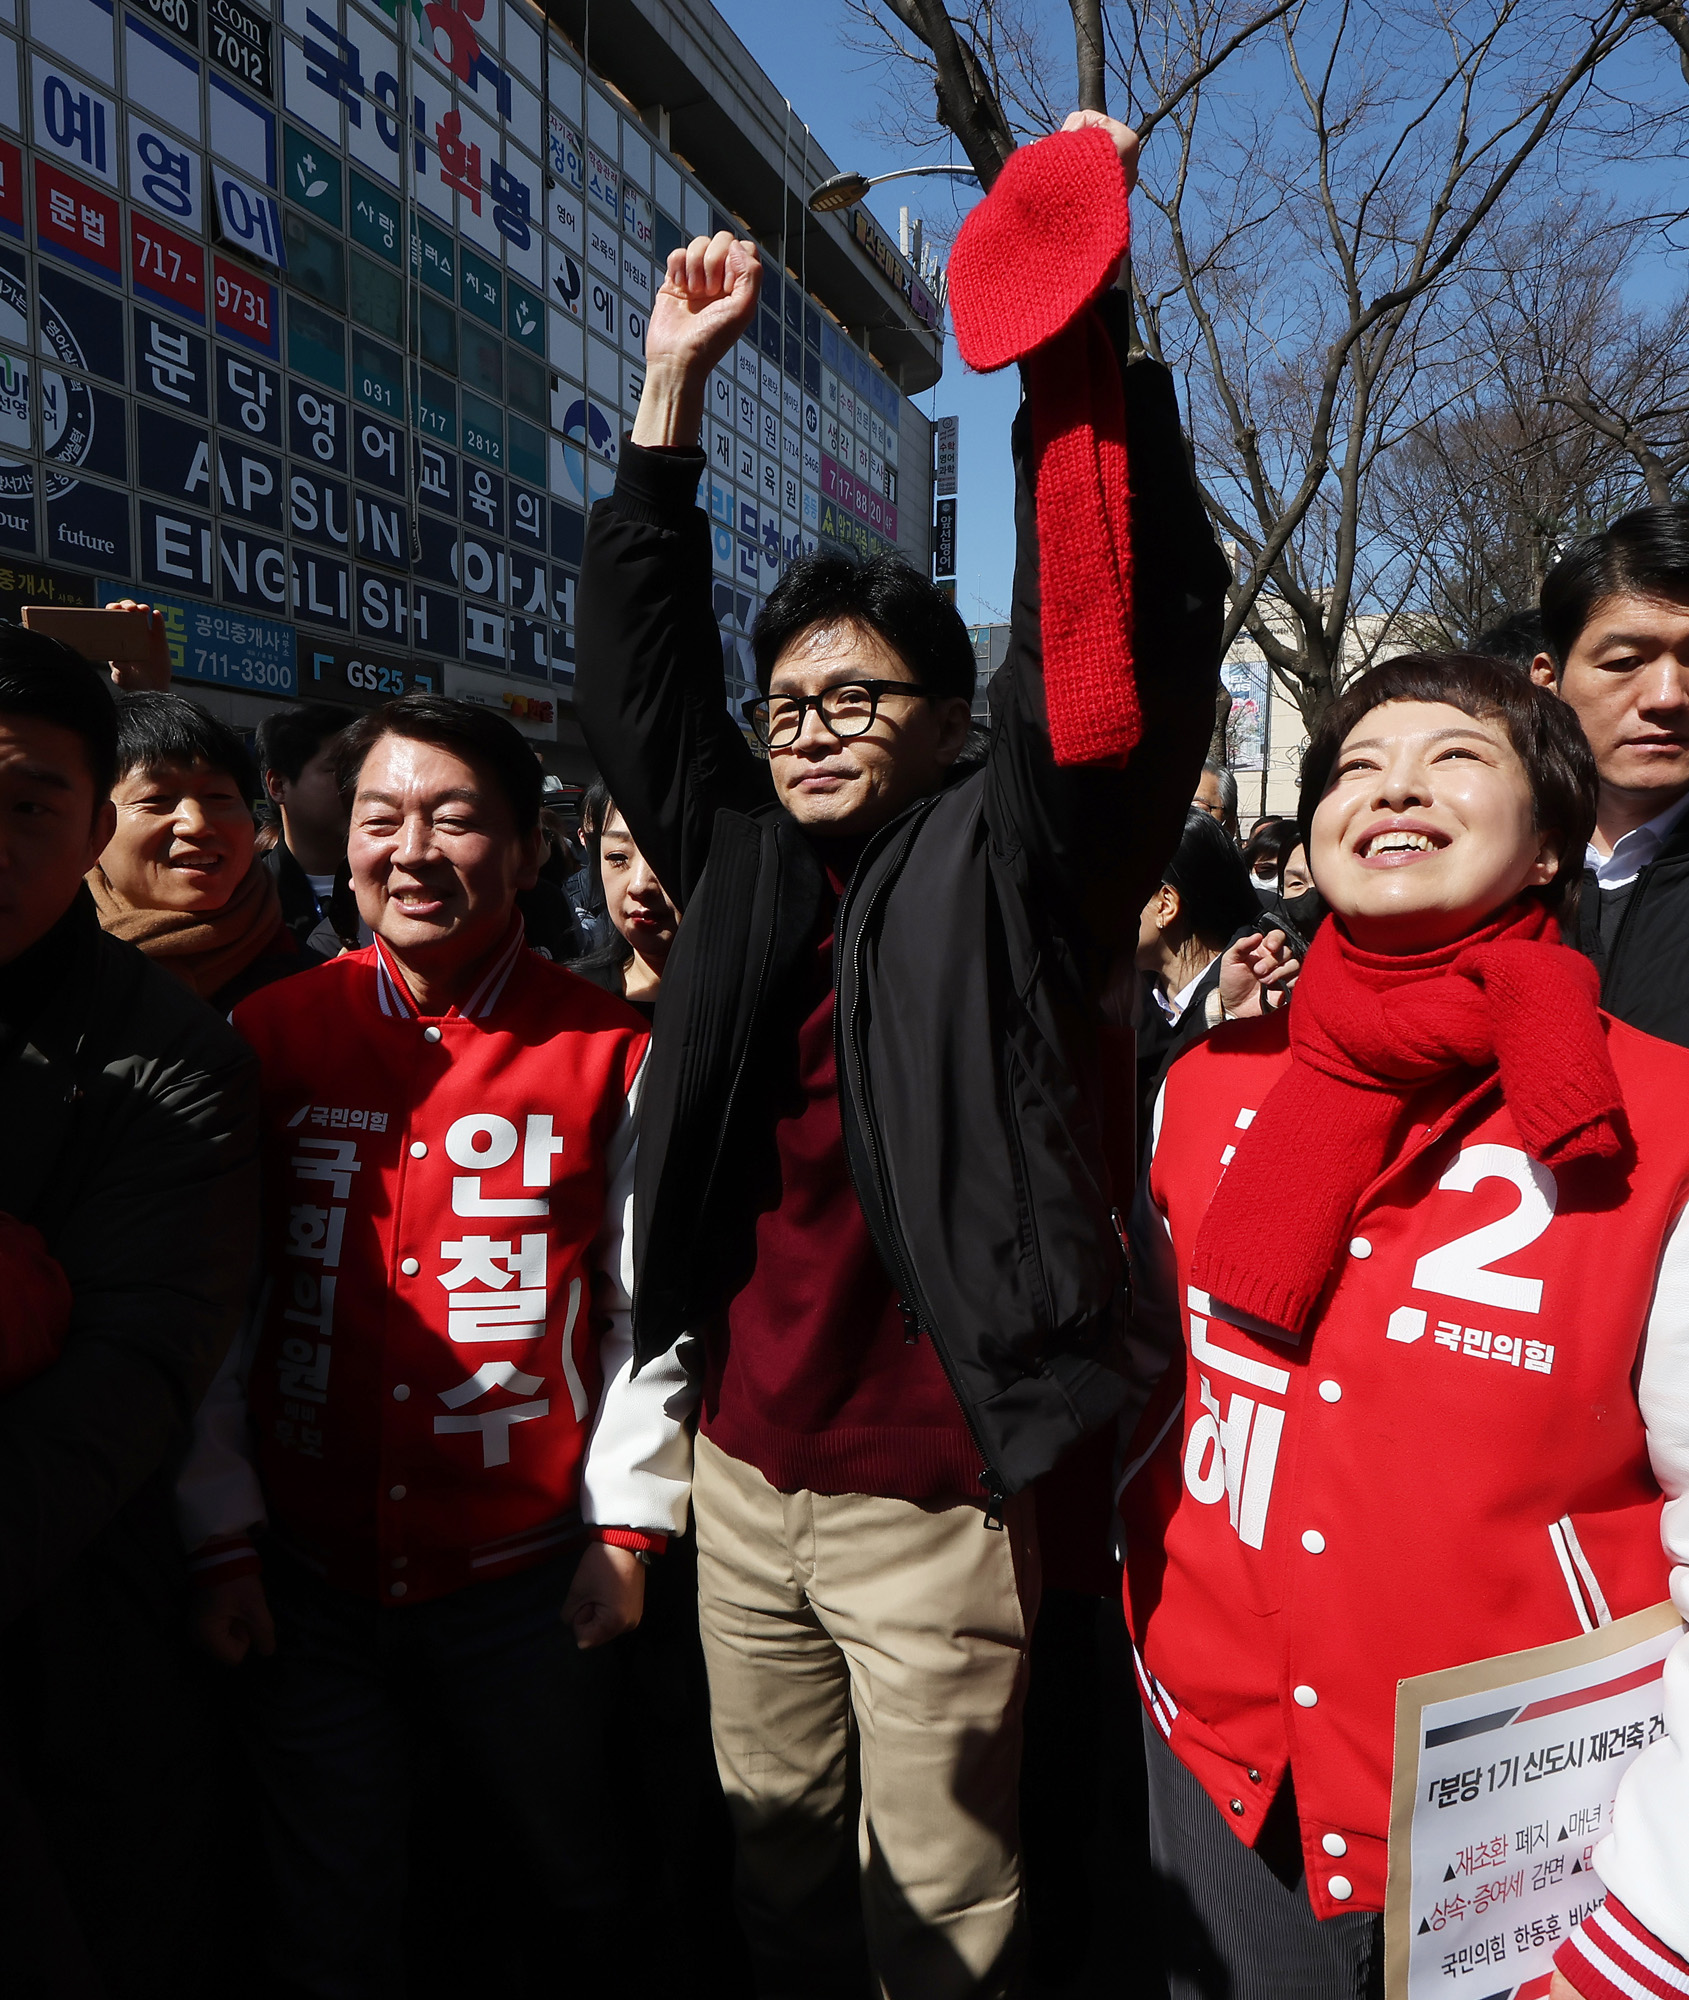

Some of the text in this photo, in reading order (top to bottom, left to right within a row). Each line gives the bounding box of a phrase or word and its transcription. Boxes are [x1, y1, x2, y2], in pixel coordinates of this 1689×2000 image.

[213, 25, 263, 86] 7012
[50, 188, 105, 248] 문법
[557, 204, 575, 233] 영어
[591, 232, 616, 266] 교육의
[637, 220, 650, 243] 3F
[363, 378, 500, 458] 031 717 2812
[184, 440, 401, 558] APSUN
[57, 523, 115, 555] future
[940, 515, 953, 569] 앞선영어
[155, 514, 428, 640] ENGLISH
[195, 613, 280, 652] 공인중개사
[194, 648, 292, 690] 711-3300
[346, 660, 404, 696] GS25
[309, 1105, 389, 1133] 국민의힘
[1411, 1143, 1558, 1315] 2
[276, 1136, 361, 1405] 국회의원
[433, 1112, 564, 1469] 안철수
[1434, 1319, 1555, 1375] 국민의힘
[1487, 1755, 1519, 1792] 1기
[1523, 1737, 1585, 1784] 신도시
[1587, 1721, 1644, 1763] 재건축
[1455, 1833, 1509, 1878] 재초환
[1515, 1820, 1550, 1855] 폐지
[1568, 1803, 1602, 1838] 매년
[1531, 1855, 1564, 1891] 감면
[1441, 1932, 1507, 1979] 국민의힘
[1514, 1913, 1562, 1953] 한동훈
